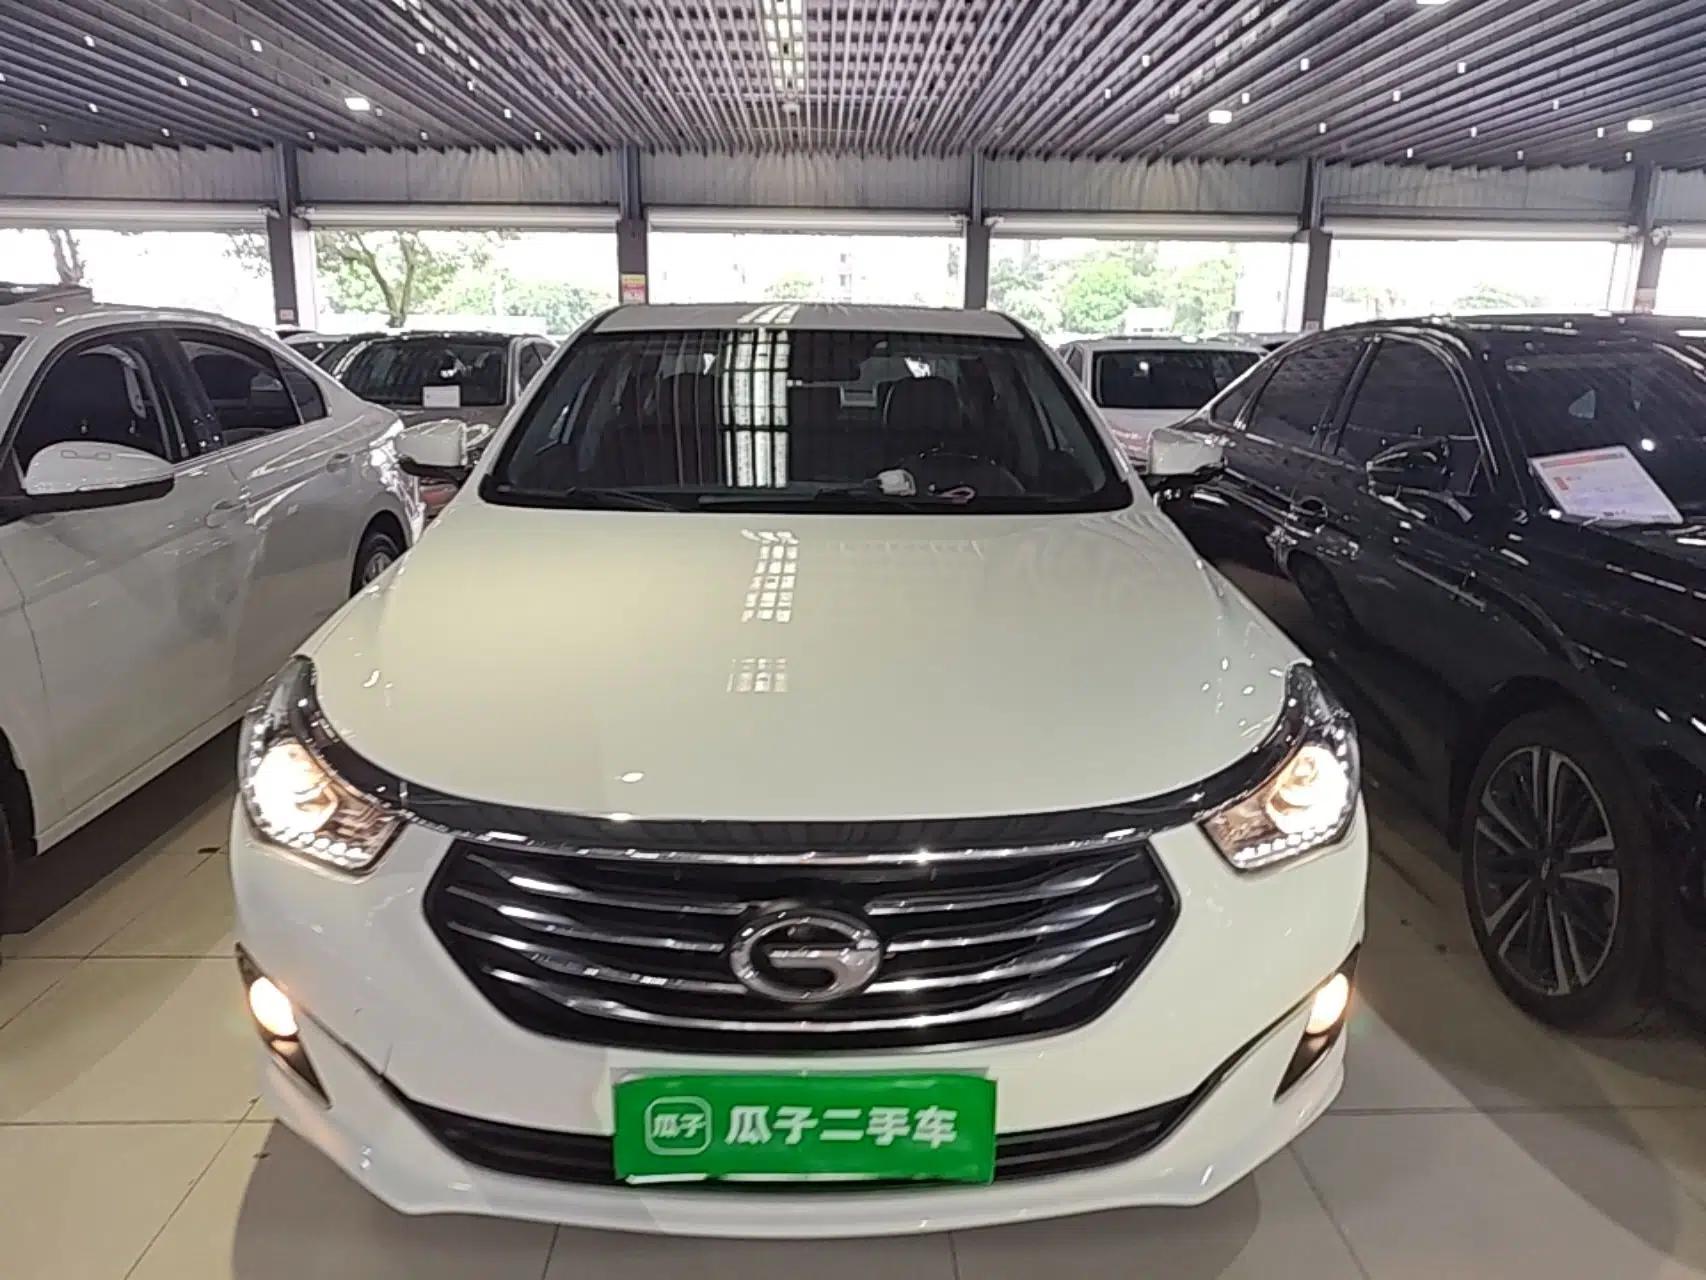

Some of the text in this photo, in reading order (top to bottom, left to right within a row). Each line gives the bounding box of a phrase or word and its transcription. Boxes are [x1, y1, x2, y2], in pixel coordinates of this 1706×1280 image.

[653, 1114, 705, 1138] 瓜子
[724, 1105, 958, 1148] 瓜子二手车
